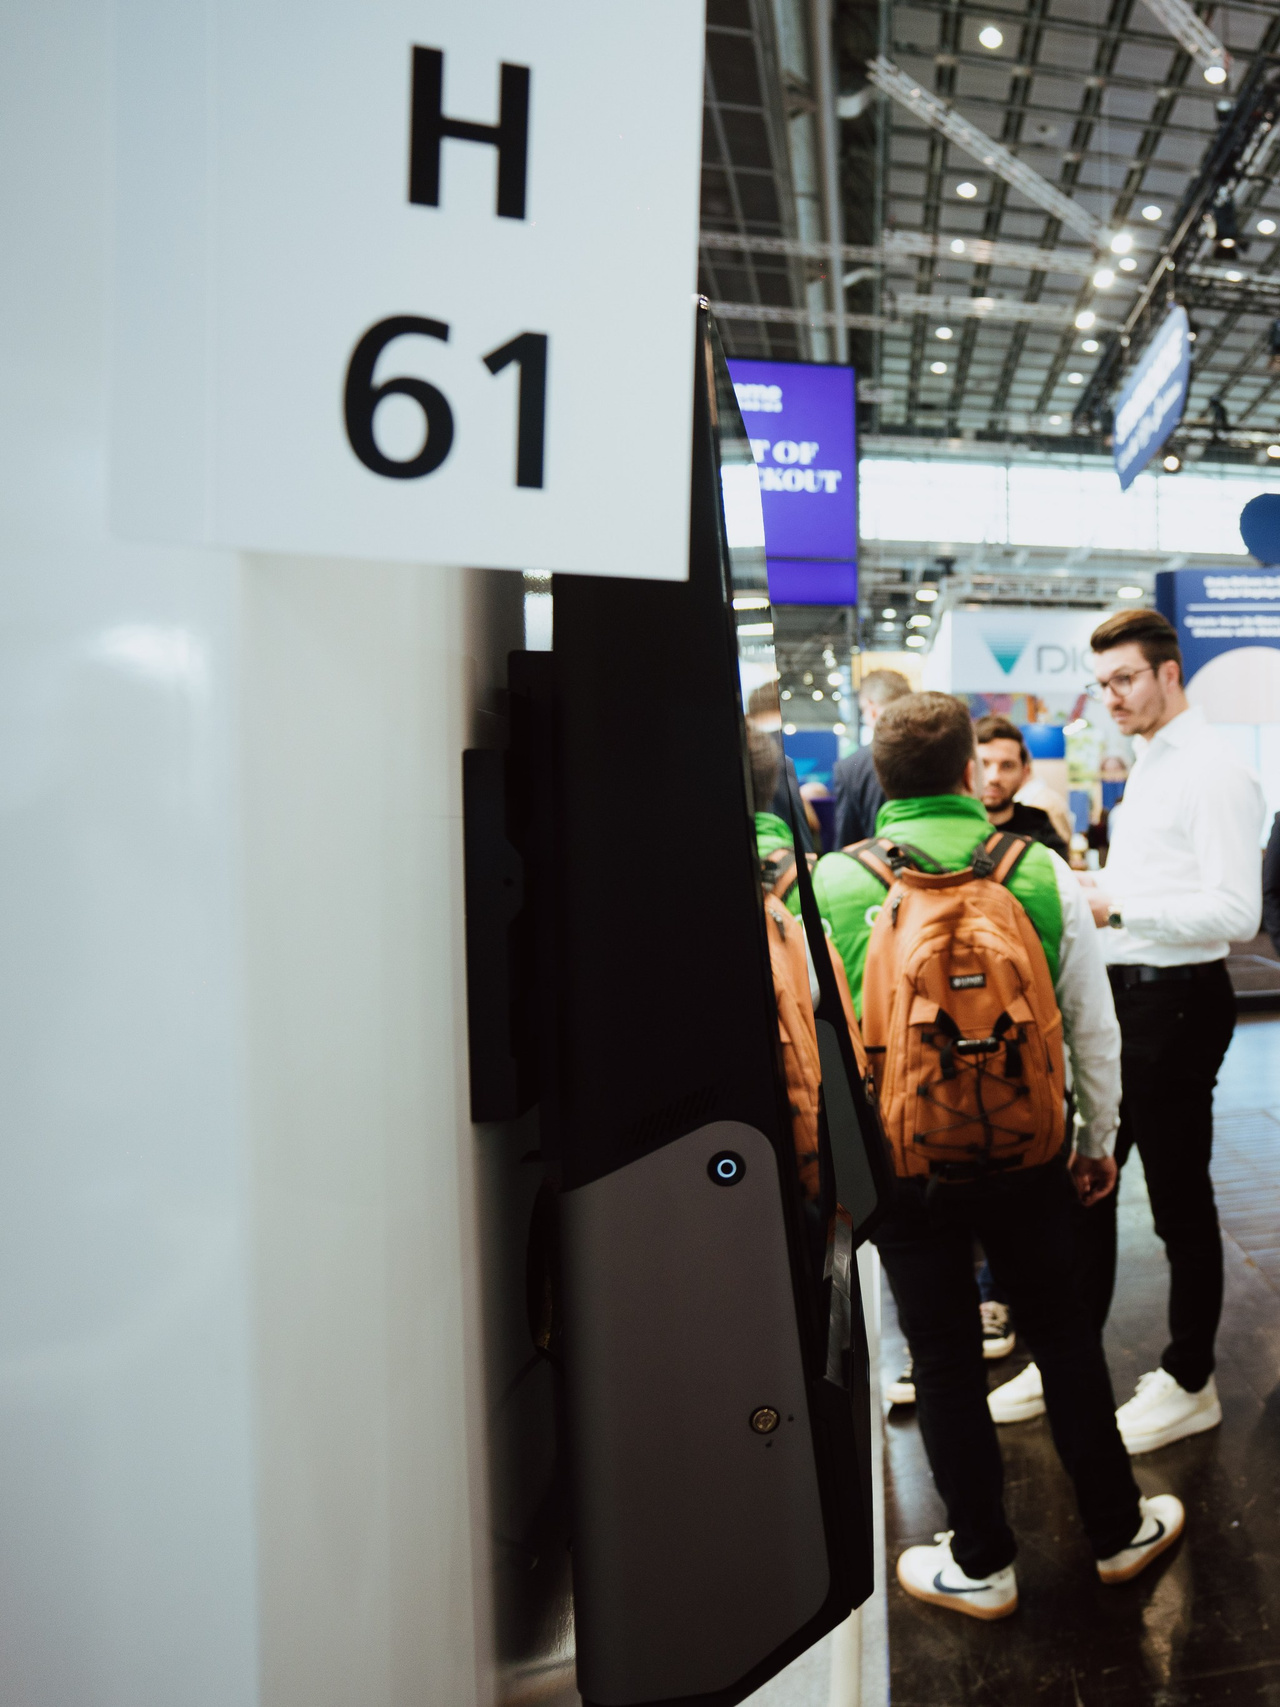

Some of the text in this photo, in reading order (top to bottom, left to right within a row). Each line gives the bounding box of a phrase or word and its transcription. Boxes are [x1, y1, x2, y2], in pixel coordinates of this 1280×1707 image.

[408, 44, 531, 220] H
[342, 313, 549, 491] 61
[771, 439, 820, 466] OF
